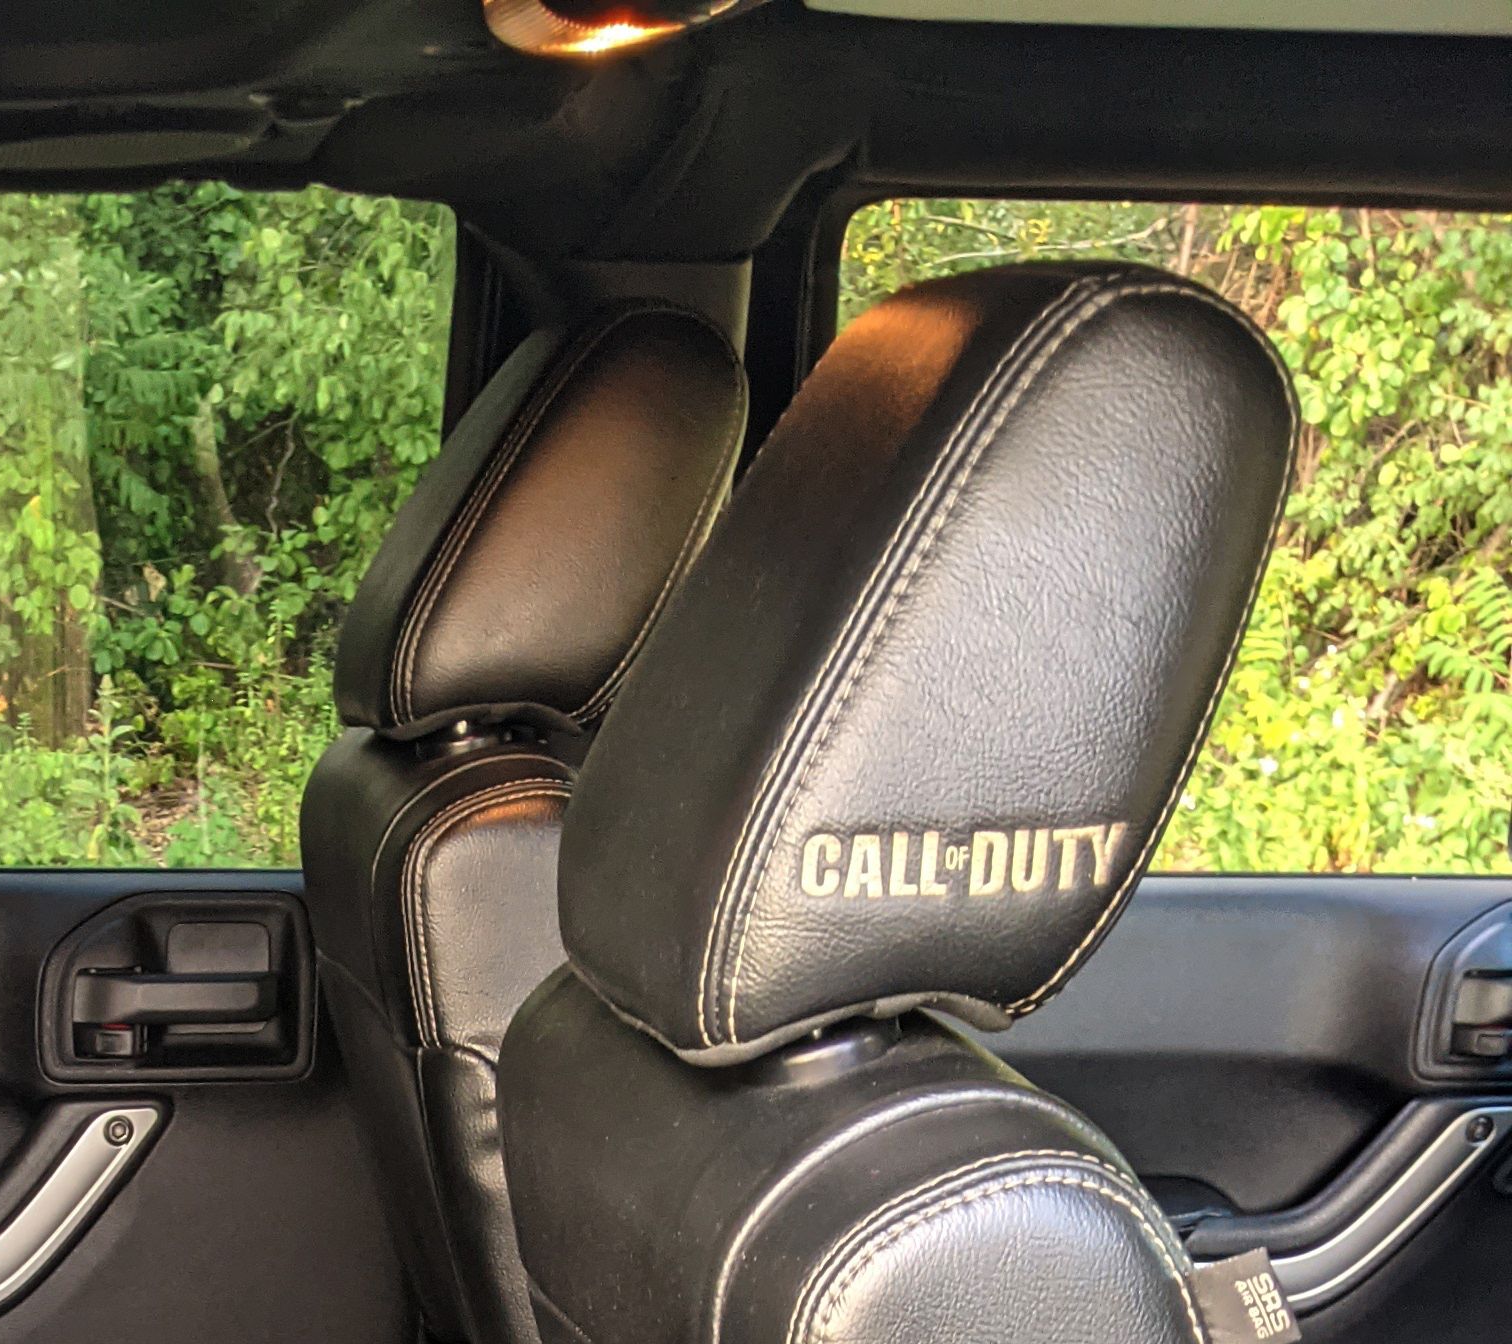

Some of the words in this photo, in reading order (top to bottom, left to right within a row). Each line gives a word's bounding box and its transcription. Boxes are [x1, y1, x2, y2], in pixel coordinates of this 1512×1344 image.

[802, 831, 946, 898] CALL
[946, 845, 969, 872] OF
[970, 822, 1128, 897] DUTY
[1234, 1280, 1254, 1306] AIR
[1248, 1306, 1269, 1339] BAG
[1257, 1273, 1290, 1333] SRS
